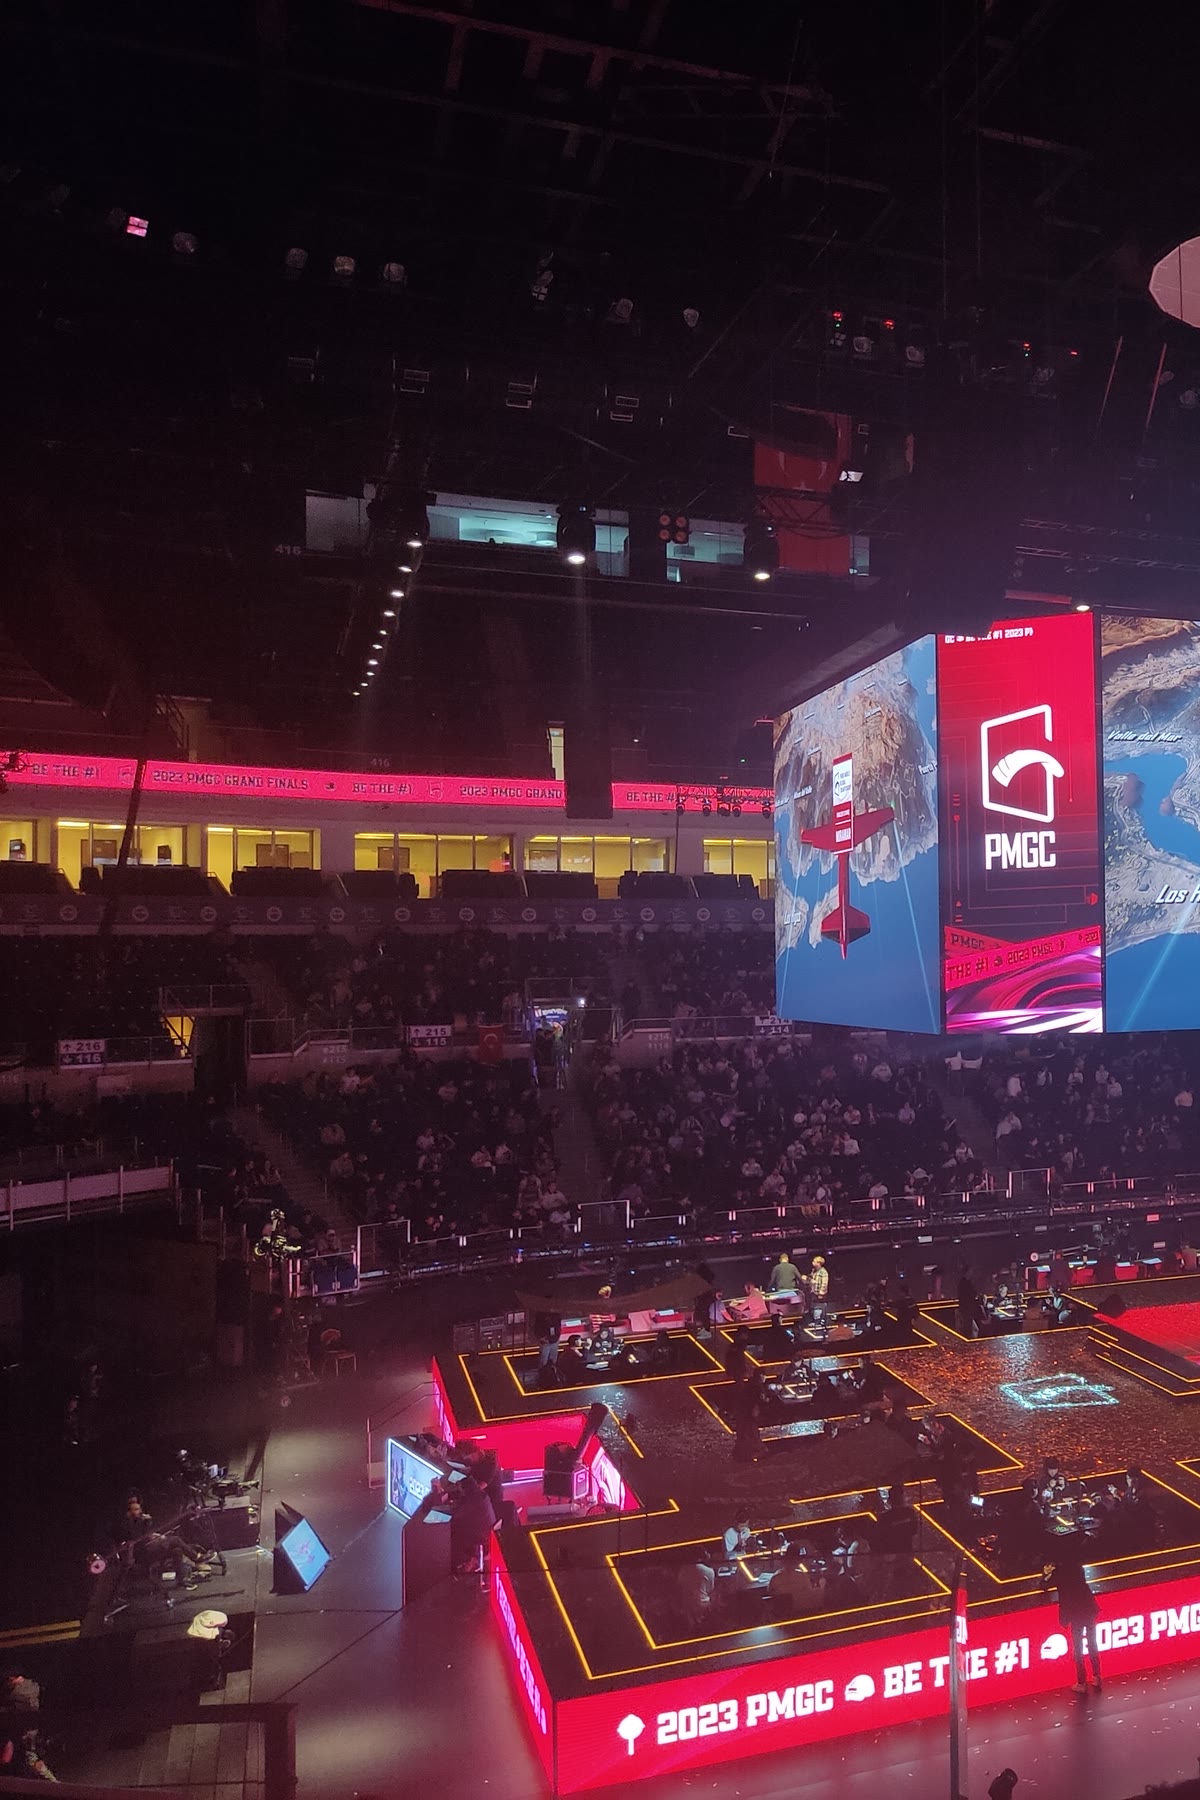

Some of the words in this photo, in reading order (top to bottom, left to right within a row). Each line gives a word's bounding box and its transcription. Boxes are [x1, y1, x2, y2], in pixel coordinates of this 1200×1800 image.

[1157, 731, 1183, 743] Mar
[32, 764, 49, 777] BE
[53, 765, 80, 778] THE
[83, 766, 101, 779] #1
[152, 771, 184, 783] 2023
[186, 772, 221, 786] PMGC
[224, 774, 263, 788] GRAND
[267, 777, 309, 791] FINALS
[352, 783, 367, 794] BE
[370, 783, 394, 794] THE
[459, 786, 488, 798] 2023
[491, 787, 523, 799] PMGC
[525, 788, 563, 800] GRAND
[626, 791, 640, 803] BE
[643, 792, 665, 803] THE
[984, 830, 1058, 871] PMGC
[1155, 884, 1189, 904] Los
[951, 933, 985, 951] PMGC
[947, 962, 972, 982] THE
[975, 957, 989, 974] #1
[1007, 947, 1030, 965] 2023
[1032, 942, 1054, 959] PMGC
[425, 1027, 447, 1036] 215
[770, 1025, 790, 1034] 114
[75, 1041, 101, 1052] 216
[426, 1037, 447, 1046] 115
[75, 1053, 101, 1064] 116
[656, 1704, 739, 1746] 2023
[746, 1679, 834, 1729] PMGC
[883, 1660, 923, 1699] BE
[994, 1637, 1030, 1676] #1
